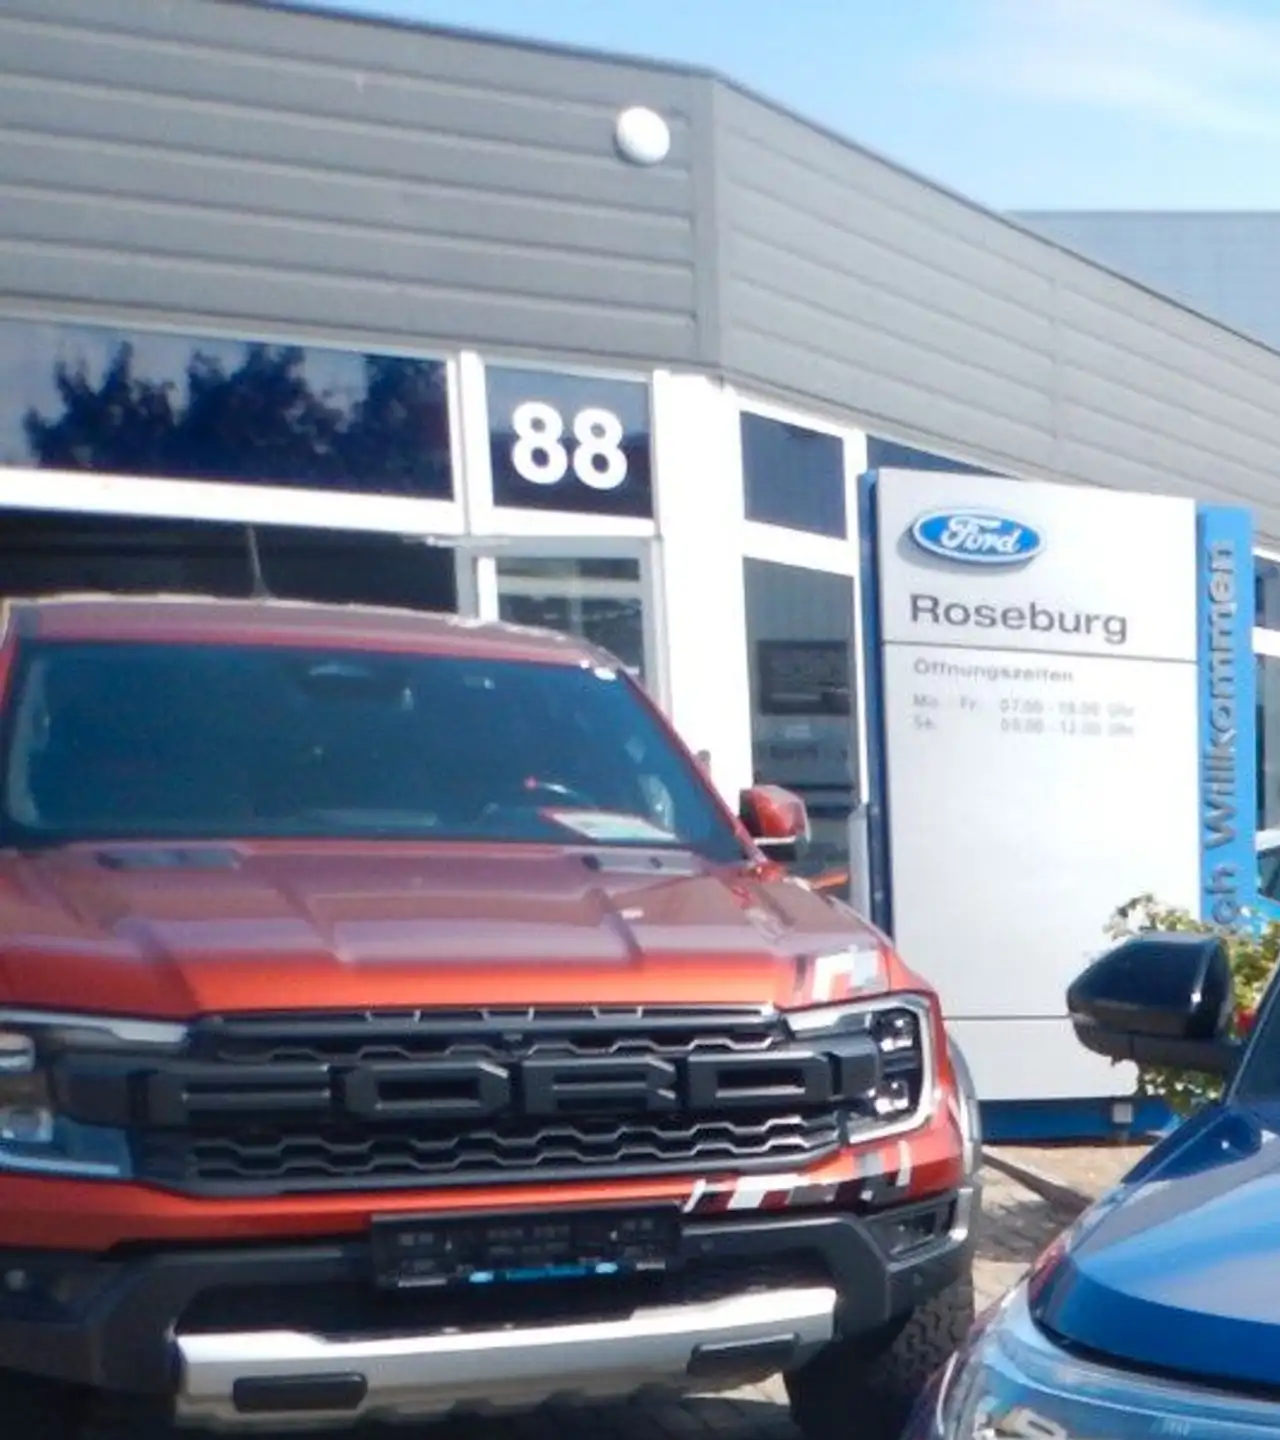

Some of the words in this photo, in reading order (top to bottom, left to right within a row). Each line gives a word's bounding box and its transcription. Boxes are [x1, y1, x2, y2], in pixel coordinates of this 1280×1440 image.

[512, 401, 628, 490] 88
[940, 515, 1022, 553] Ford
[908, 593, 1128, 645] Roseburg
[1203, 540, 1238, 850] Willkommen
[148, 1050, 834, 1127] FORD
